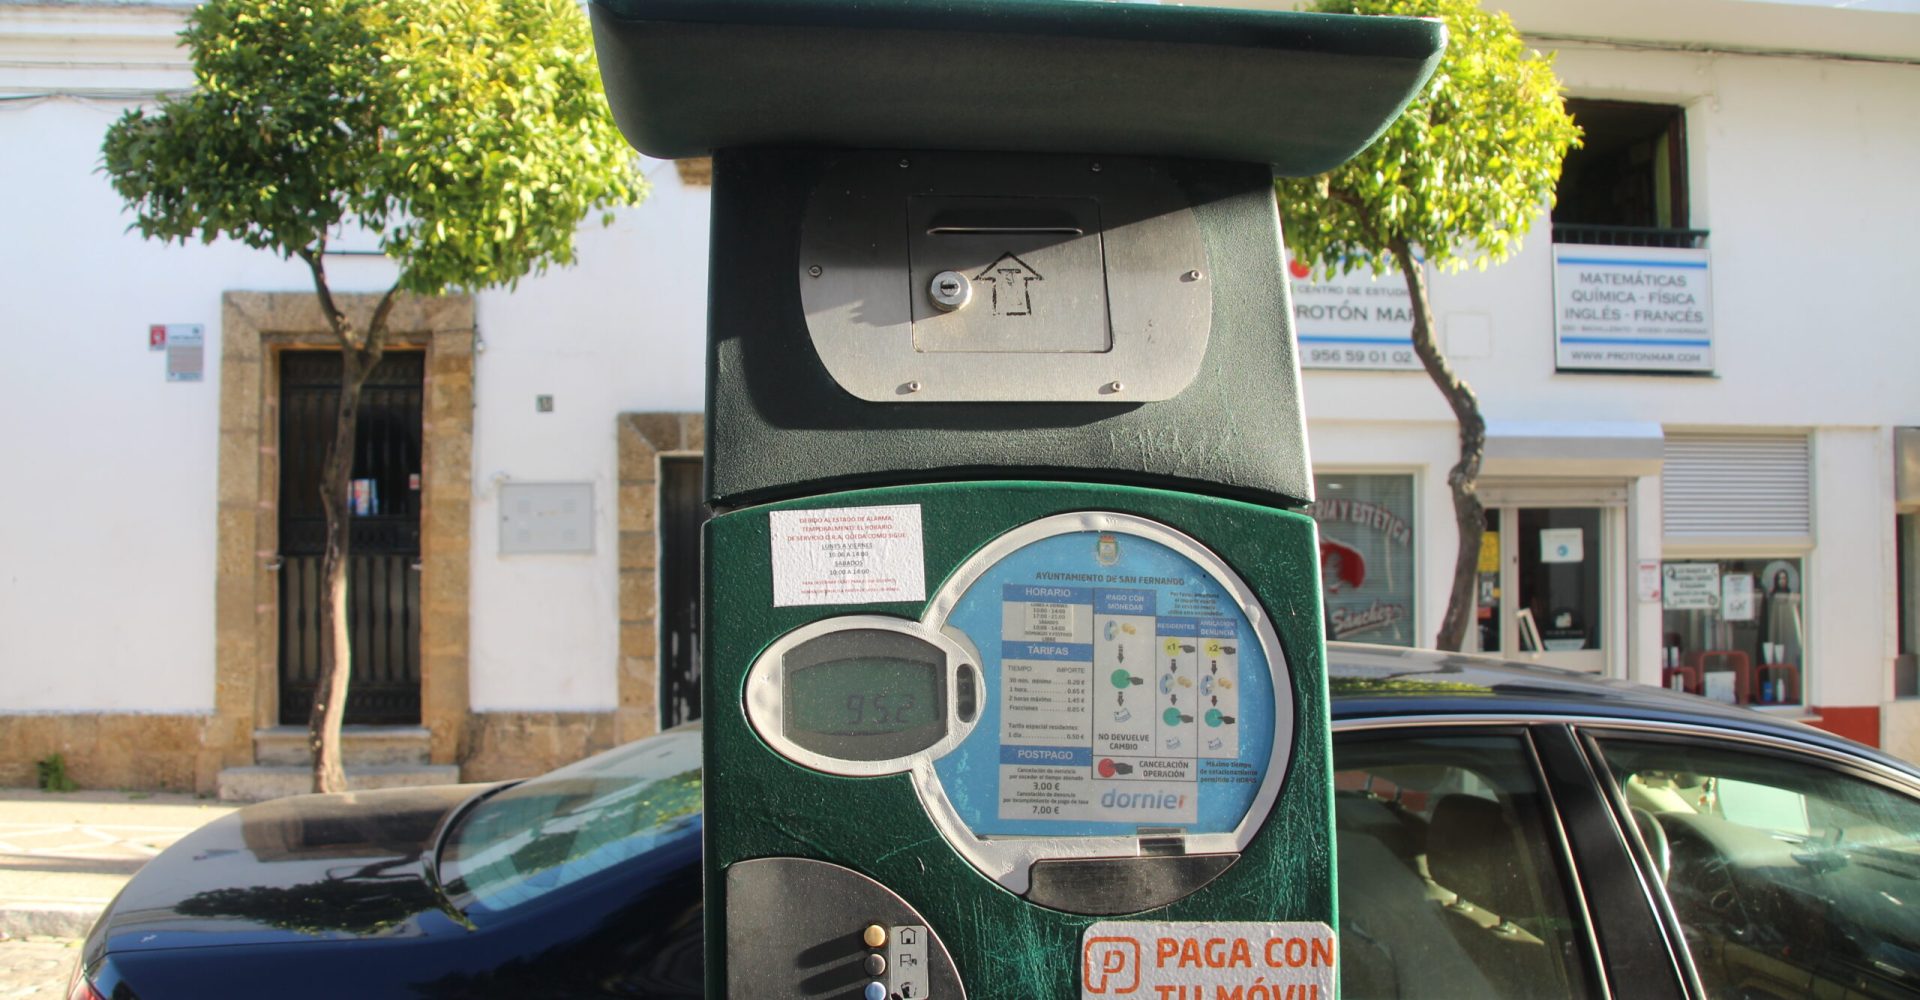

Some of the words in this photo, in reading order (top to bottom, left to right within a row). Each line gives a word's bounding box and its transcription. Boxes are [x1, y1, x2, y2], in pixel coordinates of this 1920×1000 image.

[1580, 270, 1687, 287] MATEMÁTICAS
[1298, 285, 1343, 295] CENTRO
[1347, 286, 1360, 295] DE
[1571, 288, 1636, 304] QUÍMICA
[1649, 290, 1695, 305] FÍSICA
[1296, 299, 1367, 321] ROTÓN
[1565, 305, 1621, 321] INGLÉS
[1634, 307, 1703, 323] FRANCÉS
[1311, 350, 1341, 362] 956
[1346, 350, 1365, 362] 59
[1370, 351, 1387, 363] 01
[1392, 351, 1412, 363] 02
[1571, 351, 1701, 363] WWW.PROTONMAR.COM
[1036, 572, 1104, 583] AYUNTAMIENTO
[1119, 576, 1136, 584] SAN
[1139, 577, 1185, 586] FERNANDO
[1025, 587, 1071, 597] HORARIO
[1108, 603, 1144, 611] MONEDAS
[1200, 628, 1235, 636] DENUNCIA
[1027, 645, 1069, 656] TARIFAS
[1098, 733, 1109, 741] NO
[1111, 734, 1149, 742] DEVUELVE
[1109, 743, 1138, 751] CAMBIO
[1017, 750, 1073, 760] POSTPAGO
[1139, 759, 1189, 769] CANCELACIÓN
[1143, 769, 1185, 778] OPERACIÓN
[1033, 782, 1052, 791] 3,00
[1054, 782, 1060, 791] €
[1101, 787, 1187, 809] dornier
[1033, 805, 1052, 815] 7,00
[1054, 806, 1060, 814] €
[1156, 937, 1252, 969] PAGA
[1264, 937, 1334, 968] CON
